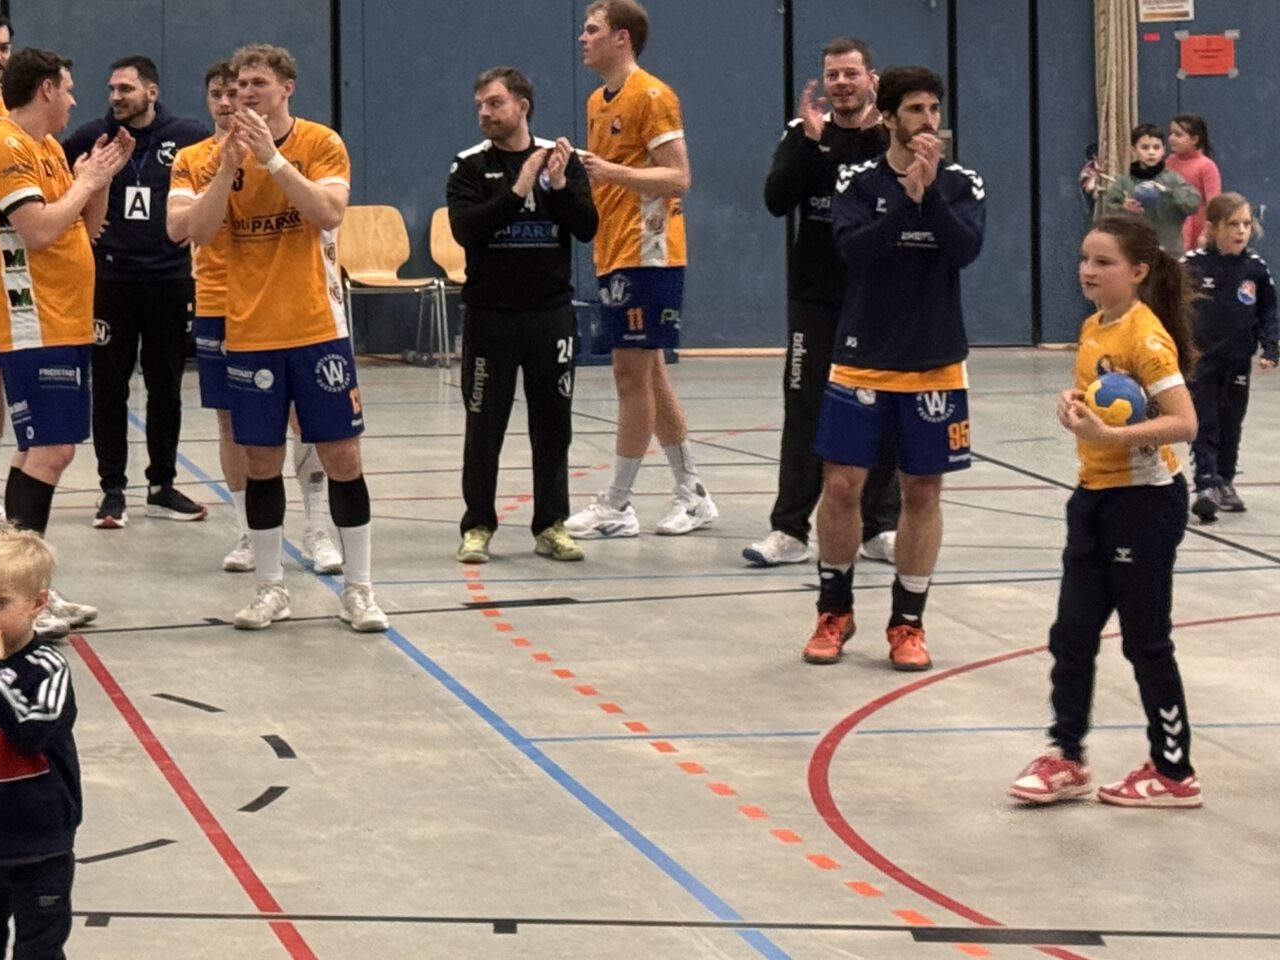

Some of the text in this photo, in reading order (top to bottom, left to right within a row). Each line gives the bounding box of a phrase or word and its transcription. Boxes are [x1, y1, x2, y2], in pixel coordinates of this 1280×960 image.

[128, 191, 148, 218] A
[626, 307, 644, 331] 11
[790, 332, 807, 390] Kempa
[470, 356, 489, 413] Kempa
[947, 420, 971, 451] 95
